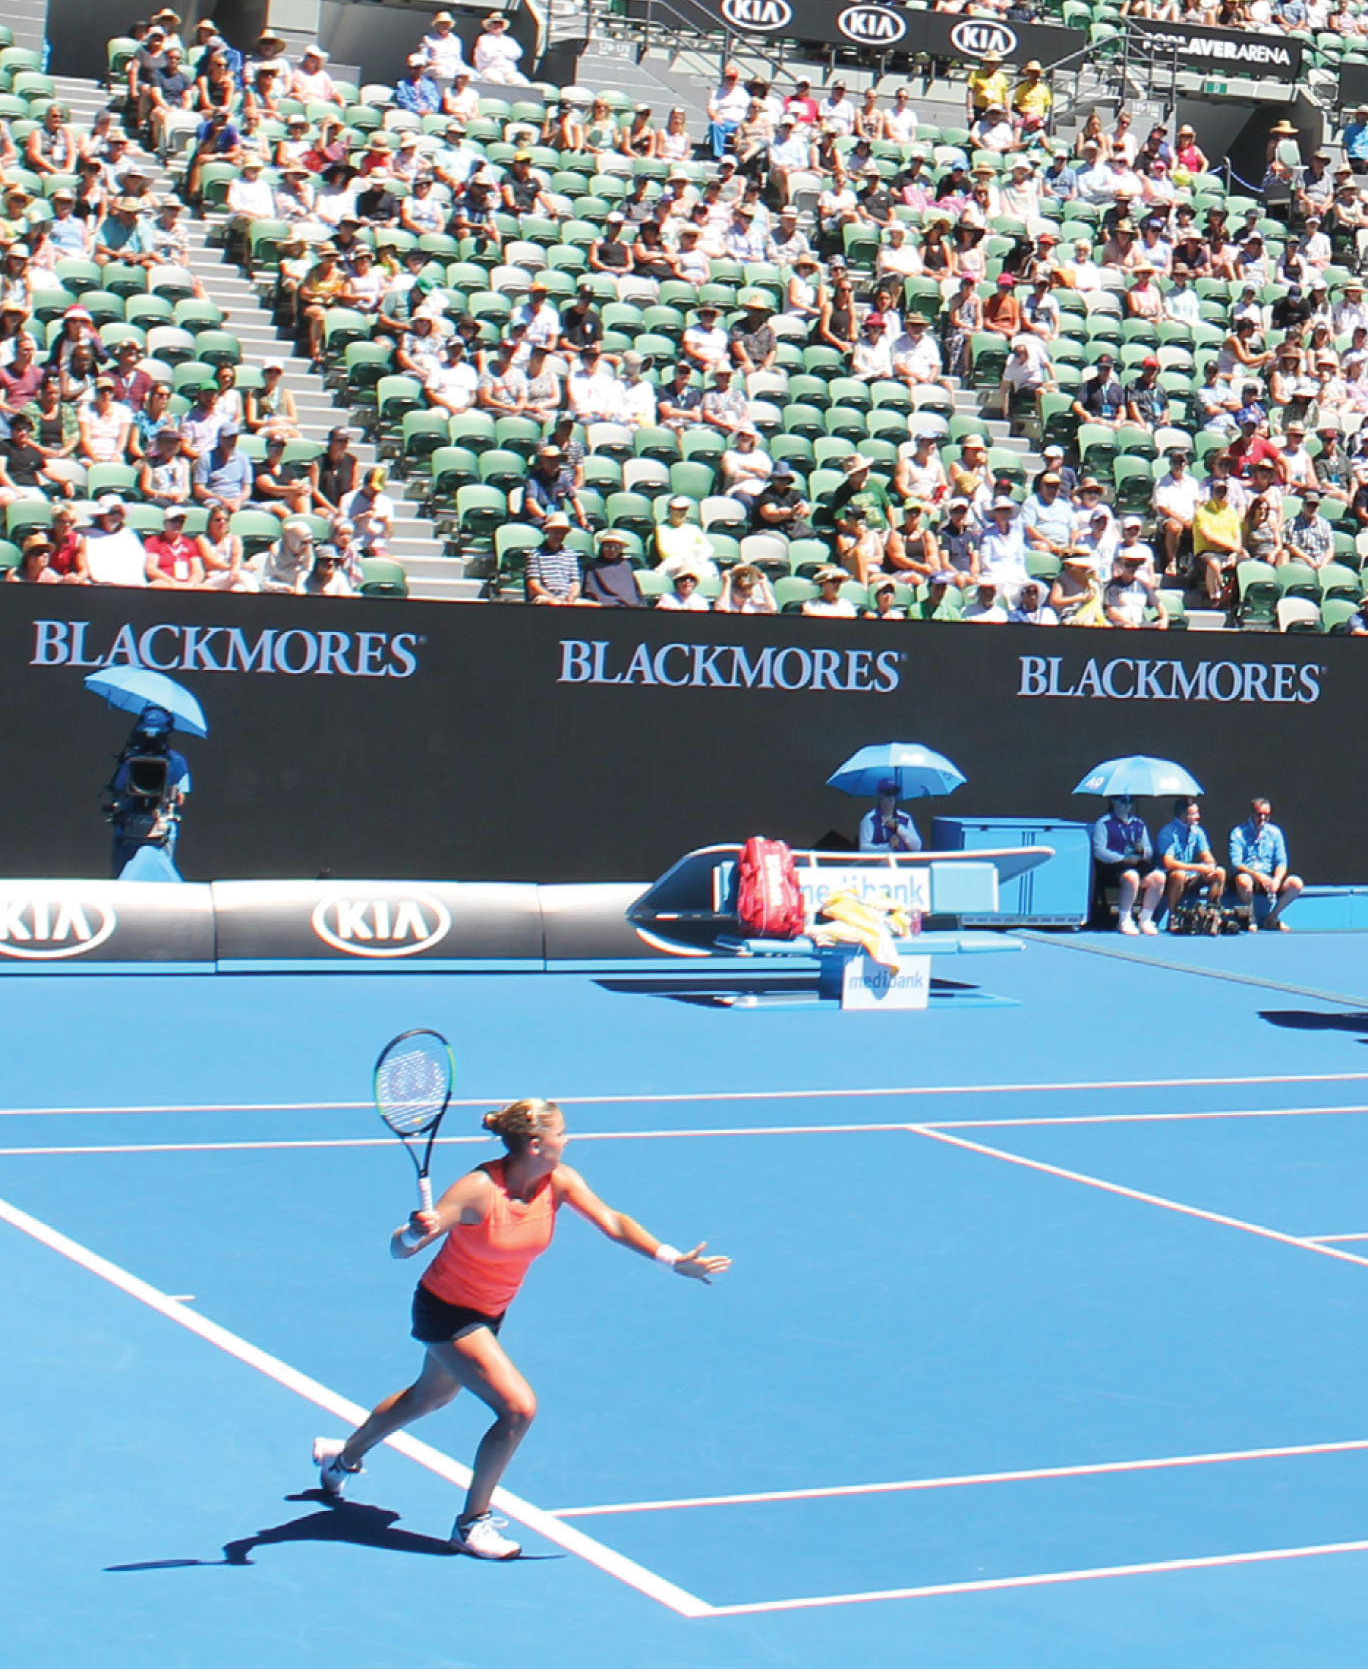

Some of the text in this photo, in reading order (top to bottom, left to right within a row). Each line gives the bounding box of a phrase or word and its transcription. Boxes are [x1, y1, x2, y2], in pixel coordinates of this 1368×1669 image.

[849, 13, 894, 38] KIA
[962, 28, 1006, 52] KIA
[30, 620, 417, 678] BLACKMORES
[557, 640, 899, 693] BLACKMORES
[1017, 655, 1321, 703] BLACKMORES
[334, 899, 430, 940] KIA
